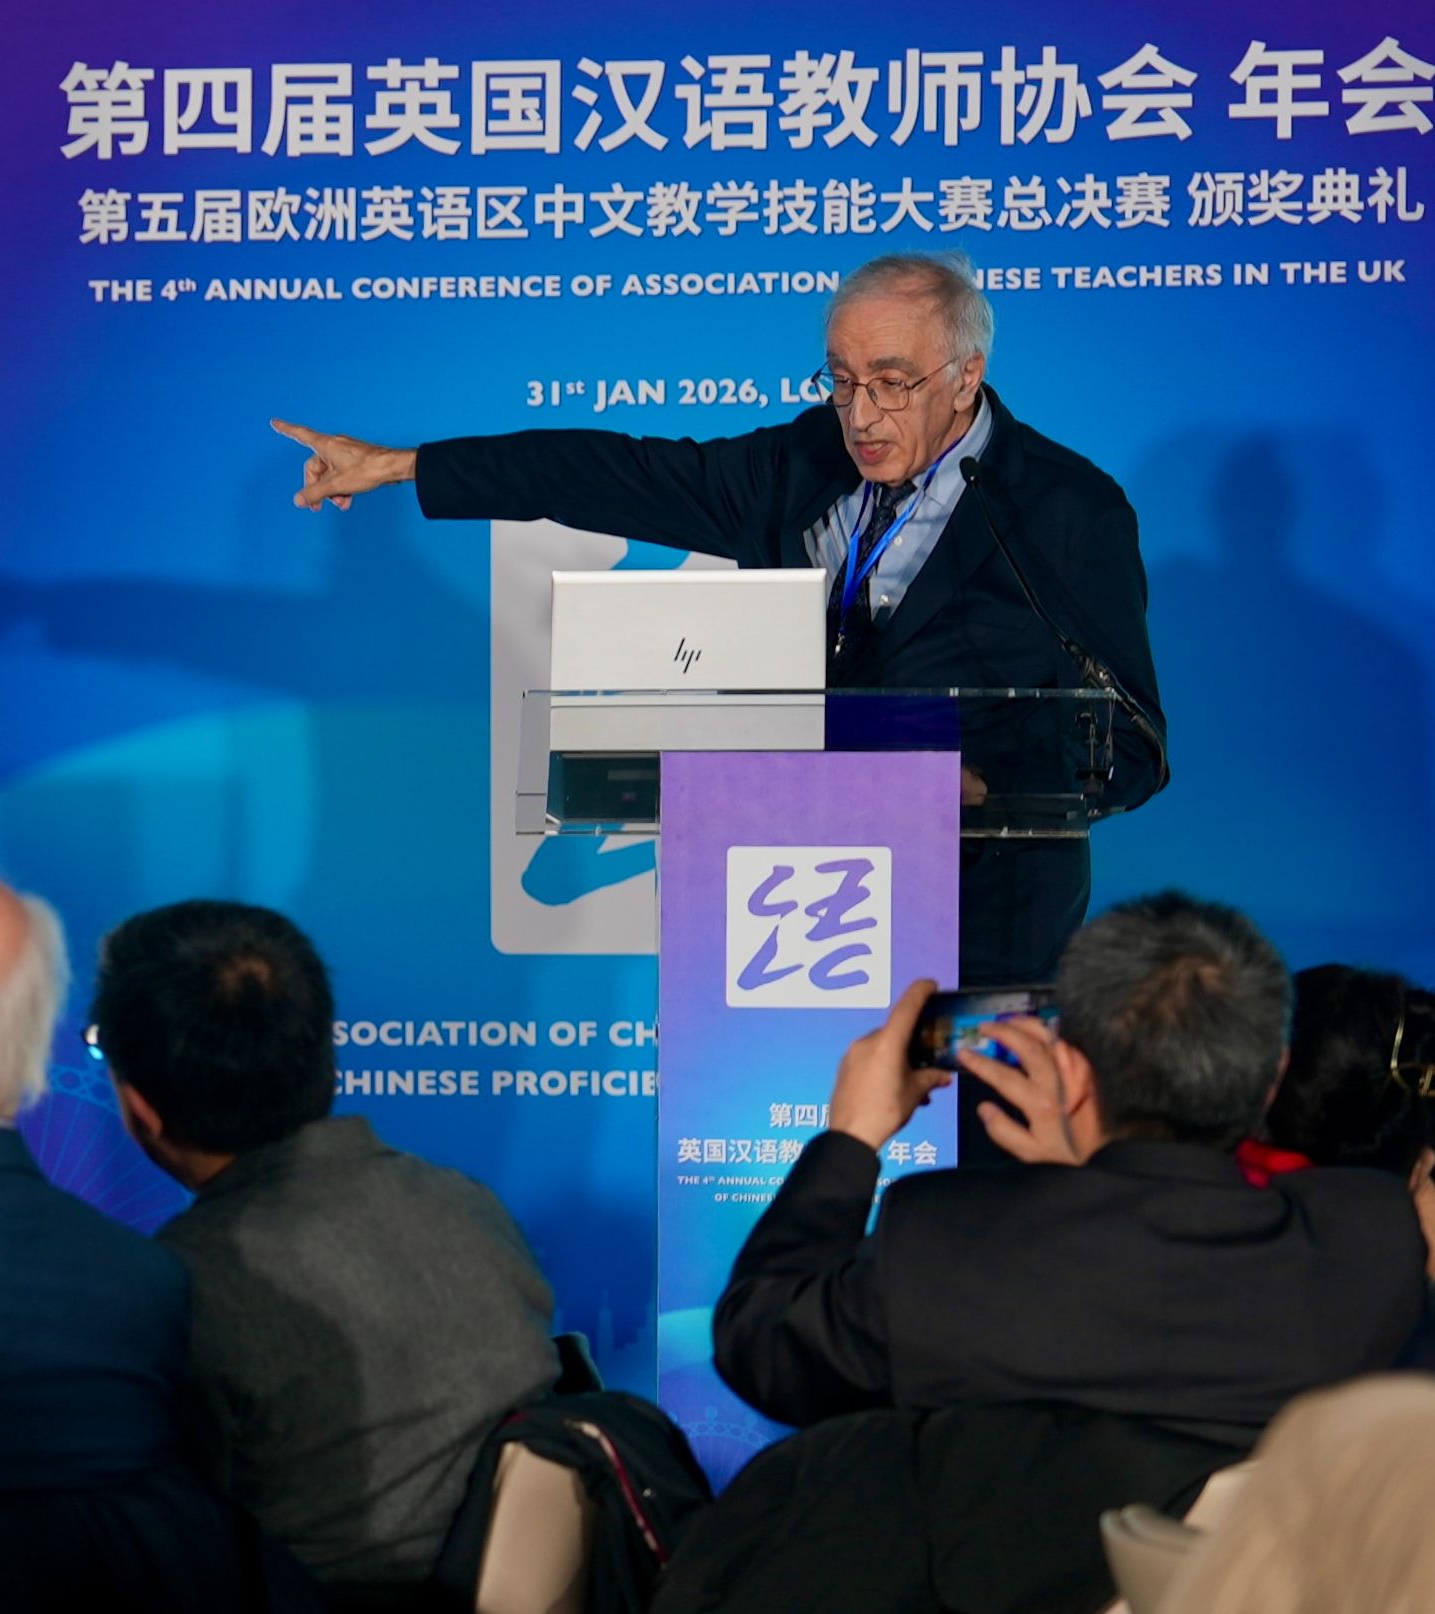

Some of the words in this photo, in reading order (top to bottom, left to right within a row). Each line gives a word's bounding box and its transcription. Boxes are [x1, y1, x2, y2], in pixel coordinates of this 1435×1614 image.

[59, 43, 1198, 160] 第四届英国汉语教师协会
[1228, 36, 1435, 139] 年会
[78, 172, 1170, 244] 第五届欧洲英语区中文教学技能大赛总决赛
[1187, 166, 1425, 226] 颁奖典礼
[88, 279, 152, 302] THE
[160, 278, 197, 301] 4th
[204, 278, 343, 301] ANNUAL
[351, 275, 561, 299] CONFERENCE
[571, 275, 611, 297] OF
[621, 271, 839, 296] ASSOCIATION
[1051, 264, 1222, 289] TEACHERS
[1233, 263, 1269, 285] IN
[1279, 261, 1347, 284] THE
[1357, 260, 1405, 283] UK
[527, 381, 584, 406] 31st
[593, 380, 665, 412] JAN
[679, 379, 768, 407] 2026,
[333, 1021, 537, 1047] SOCIATION
[549, 1021, 596, 1046] OF
[491, 1070, 656, 1097] PROFICIE
[887, 1140, 937, 1166] 年会
[677, 1176, 700, 1185] THE
[718, 1176, 767, 1185] ANNUAL
[714, 1193, 729, 1202] OF
